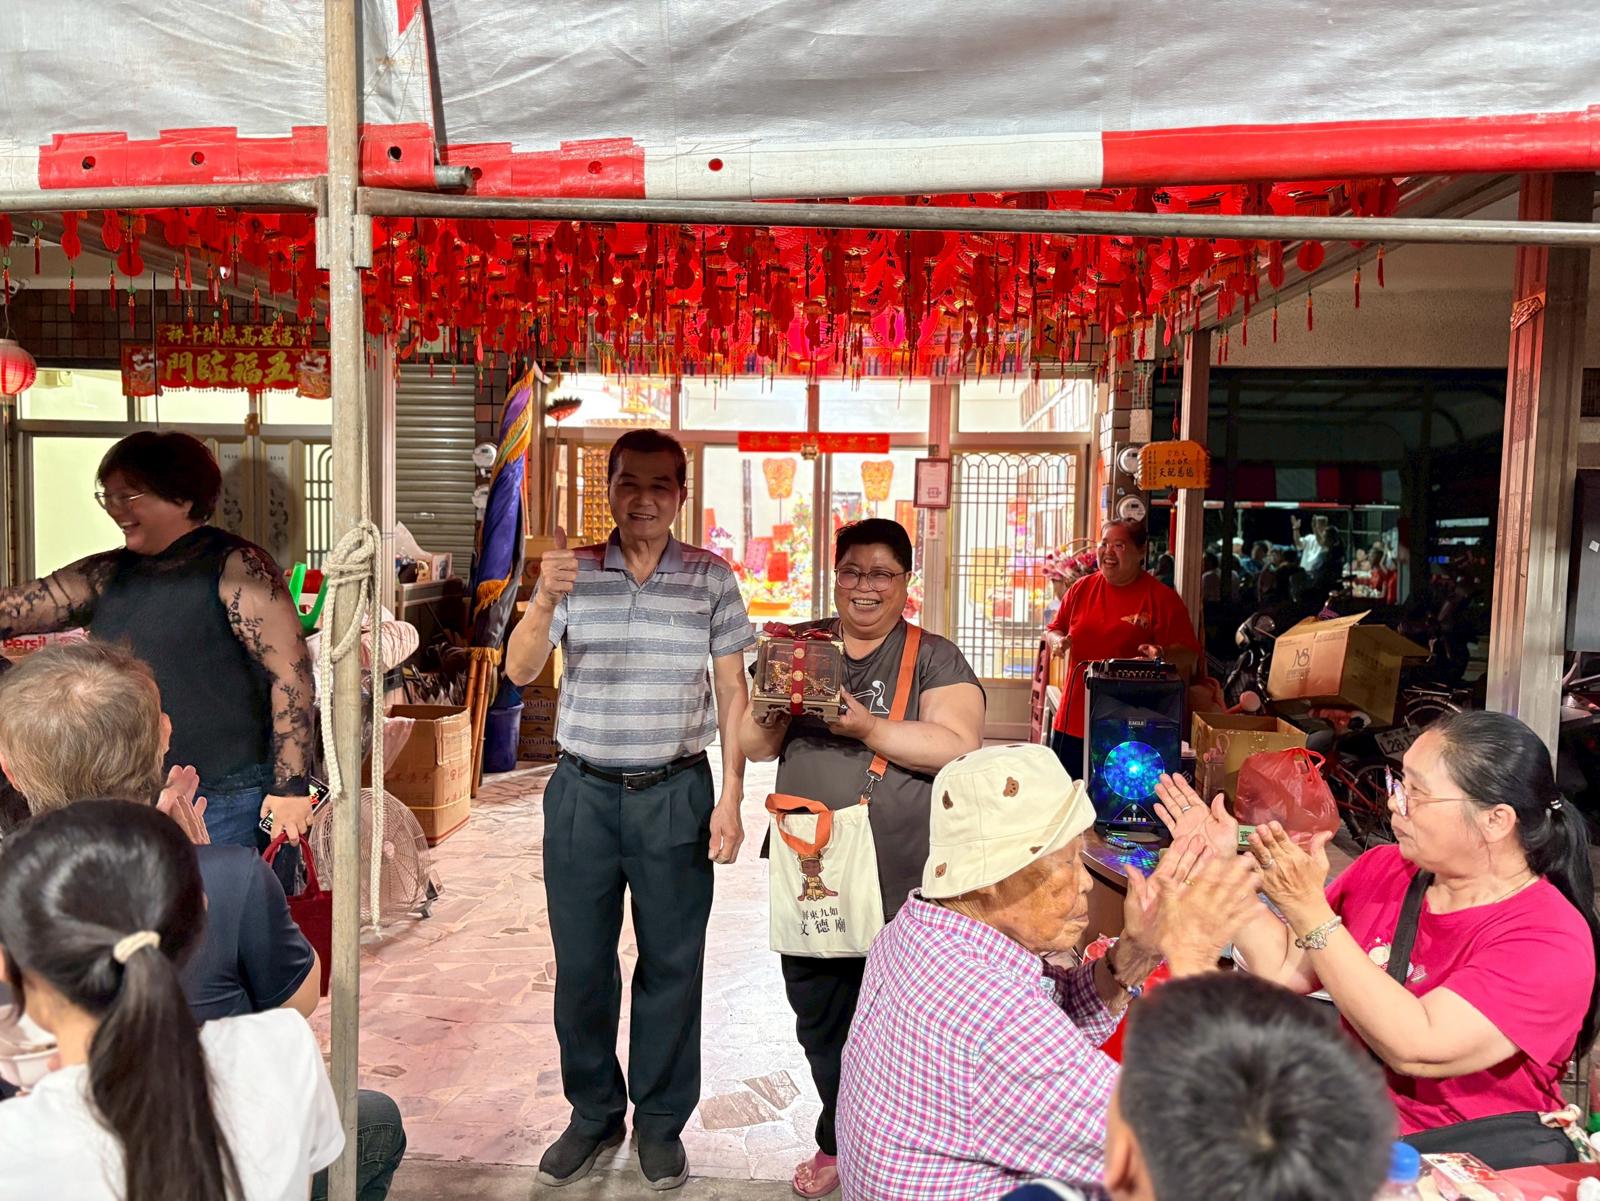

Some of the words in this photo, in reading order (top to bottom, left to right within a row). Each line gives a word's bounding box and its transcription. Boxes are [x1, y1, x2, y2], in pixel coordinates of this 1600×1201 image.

[165, 350, 294, 385] 五福臨門
[3, 635, 46, 651] Persil
[800, 917, 846, 936] 文德廟
